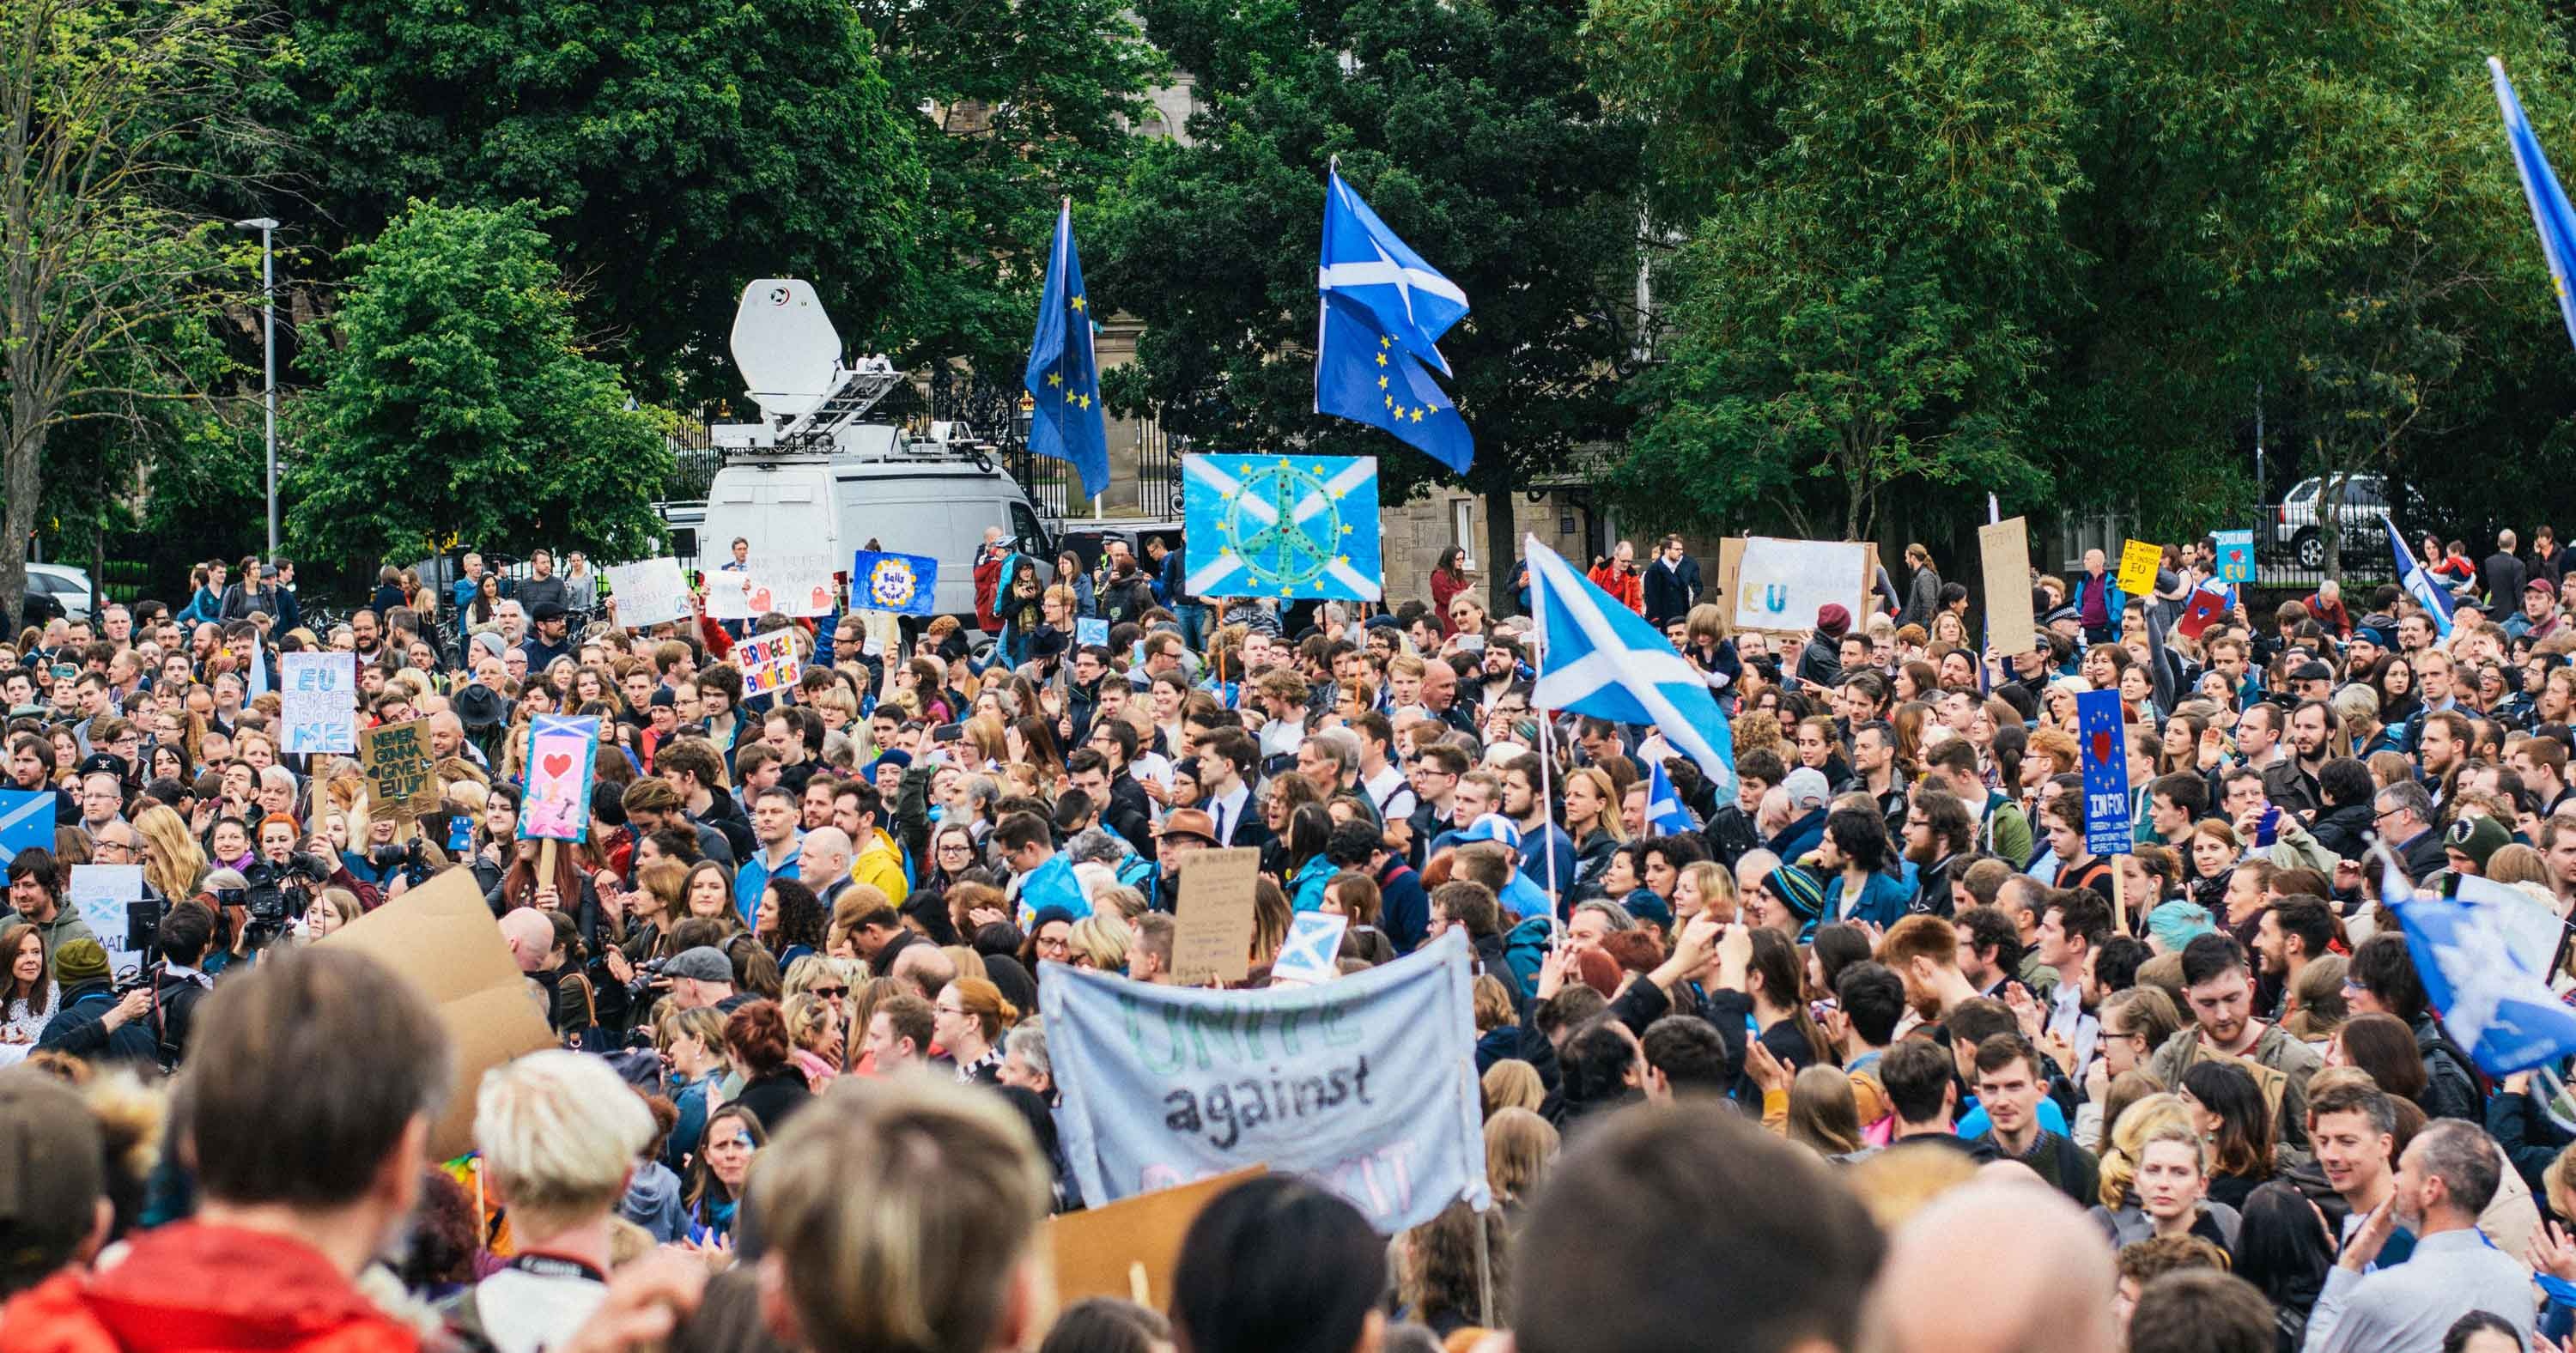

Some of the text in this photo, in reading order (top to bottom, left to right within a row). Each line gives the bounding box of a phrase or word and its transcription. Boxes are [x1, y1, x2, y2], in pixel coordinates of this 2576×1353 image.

[2129, 562, 2146, 574] EU
[2225, 563, 2246, 580] EU
[1742, 582, 1787, 615] EU
[740, 634, 792, 667] BRIDGES
[298, 669, 336, 692] EU
[292, 723, 349, 751] ME
[372, 726, 421, 749] NEVER
[374, 743, 425, 764] GONNA
[380, 760, 417, 779] GIVE
[379, 778, 403, 798] EU
[1119, 991, 1364, 1076] UNITE
[1163, 1053, 1374, 1150] against
